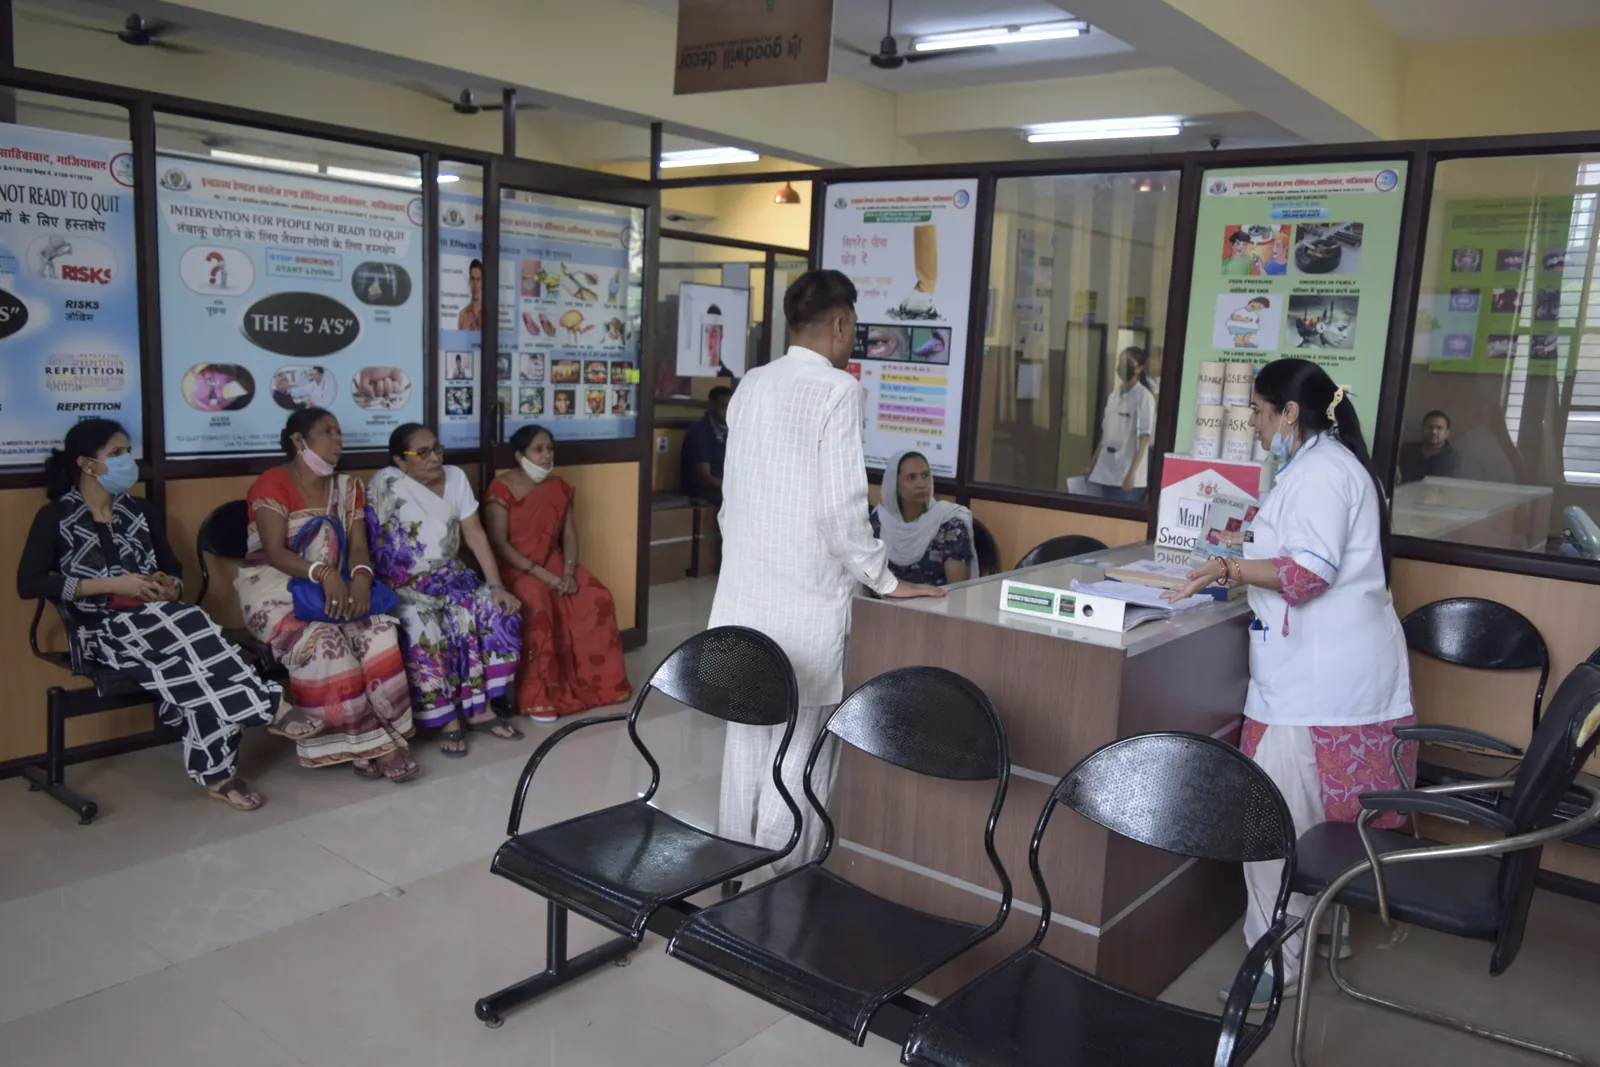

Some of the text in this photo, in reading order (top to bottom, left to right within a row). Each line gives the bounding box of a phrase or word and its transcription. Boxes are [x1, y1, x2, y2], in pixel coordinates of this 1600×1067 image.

[678, 50, 716, 71] decor
[723, 36, 782, 69] goodwill
[0, 184, 120, 215] NOT READY TO QUIT
[37, 212, 59, 228] लिए
[170, 204, 405, 242] INTERVENTION FOR PEOPLE NOT READY TO QUIT
[65, 300, 100, 310] RISKS
[252, 314, 289, 333] THE
[45, 366, 124, 376] REPETITION
[57, 402, 122, 412] REPETITION
[1228, 417, 1248, 431] ASK
[1179, 503, 1211, 529] Marl
